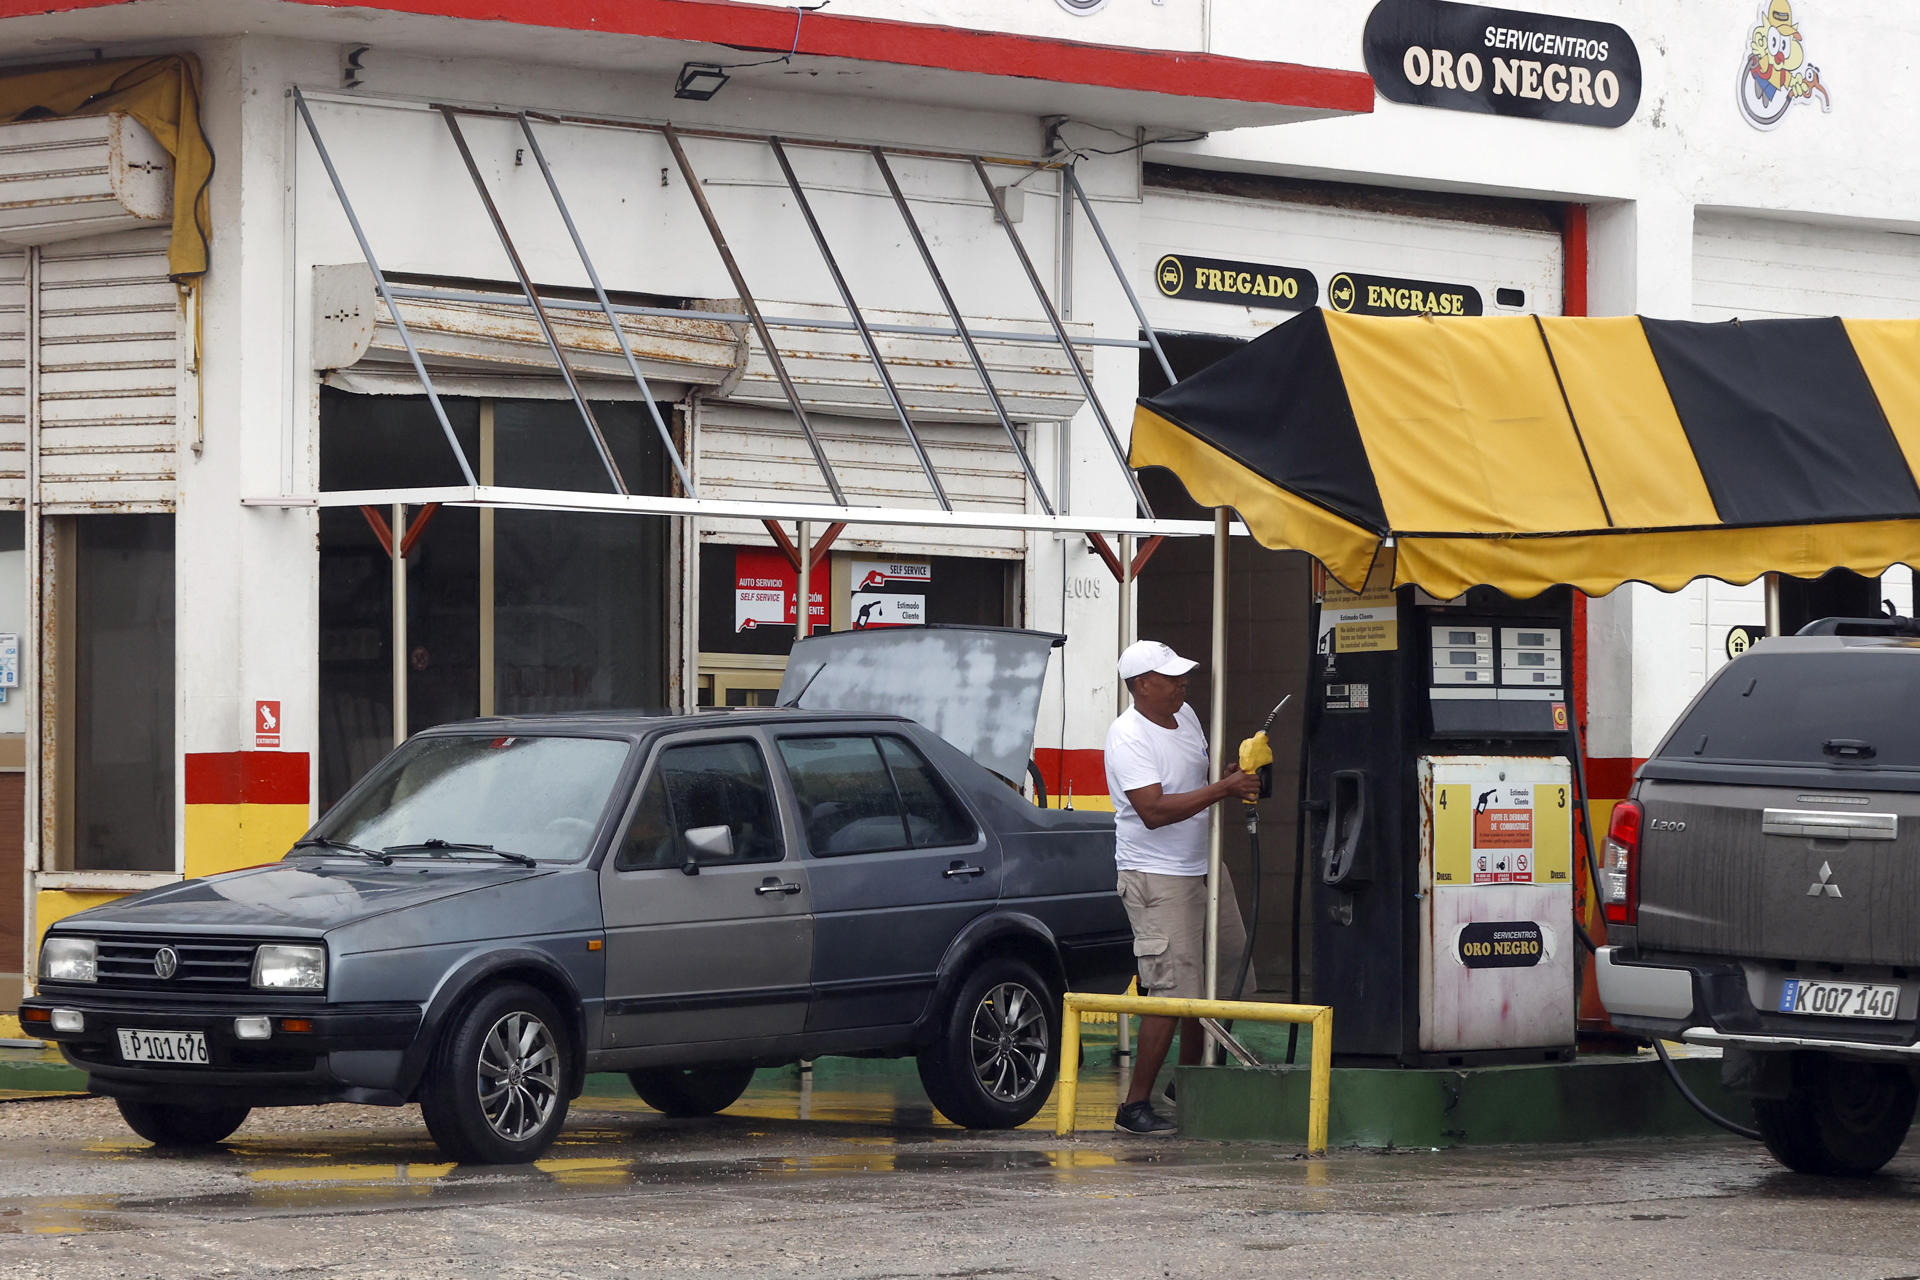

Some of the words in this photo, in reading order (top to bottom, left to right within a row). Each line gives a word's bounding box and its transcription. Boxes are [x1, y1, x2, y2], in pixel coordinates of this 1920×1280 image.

[1484, 26, 1609, 61] SERVICENTROS
[1403, 45, 1483, 92] ORO
[1492, 57, 1620, 108] NEGRO
[1195, 267, 1298, 299] FREGADO
[1367, 285, 1464, 316] ENGRASE
[890, 565, 903, 575] SELF
[904, 565, 927, 576] SERVICE
[739, 578, 755, 587] AUTO
[756, 578, 783, 588] SERVICIO
[740, 592, 755, 601] SELF
[756, 593, 781, 602] SERVICE
[792, 592, 823, 603] ACIÓN
[897, 601, 920, 610] Estimado
[902, 611, 920, 620] Cliente
[1510, 788, 1529, 796] Estimado
[1557, 787, 1566, 809] 3
[1439, 789, 1447, 810] 4
[1650, 818, 1686, 832] L200
[1493, 931, 1537, 940] SERVICENTROS
[1464, 942, 1491, 956] ORO
[1493, 940, 1539, 955] NEGRO
